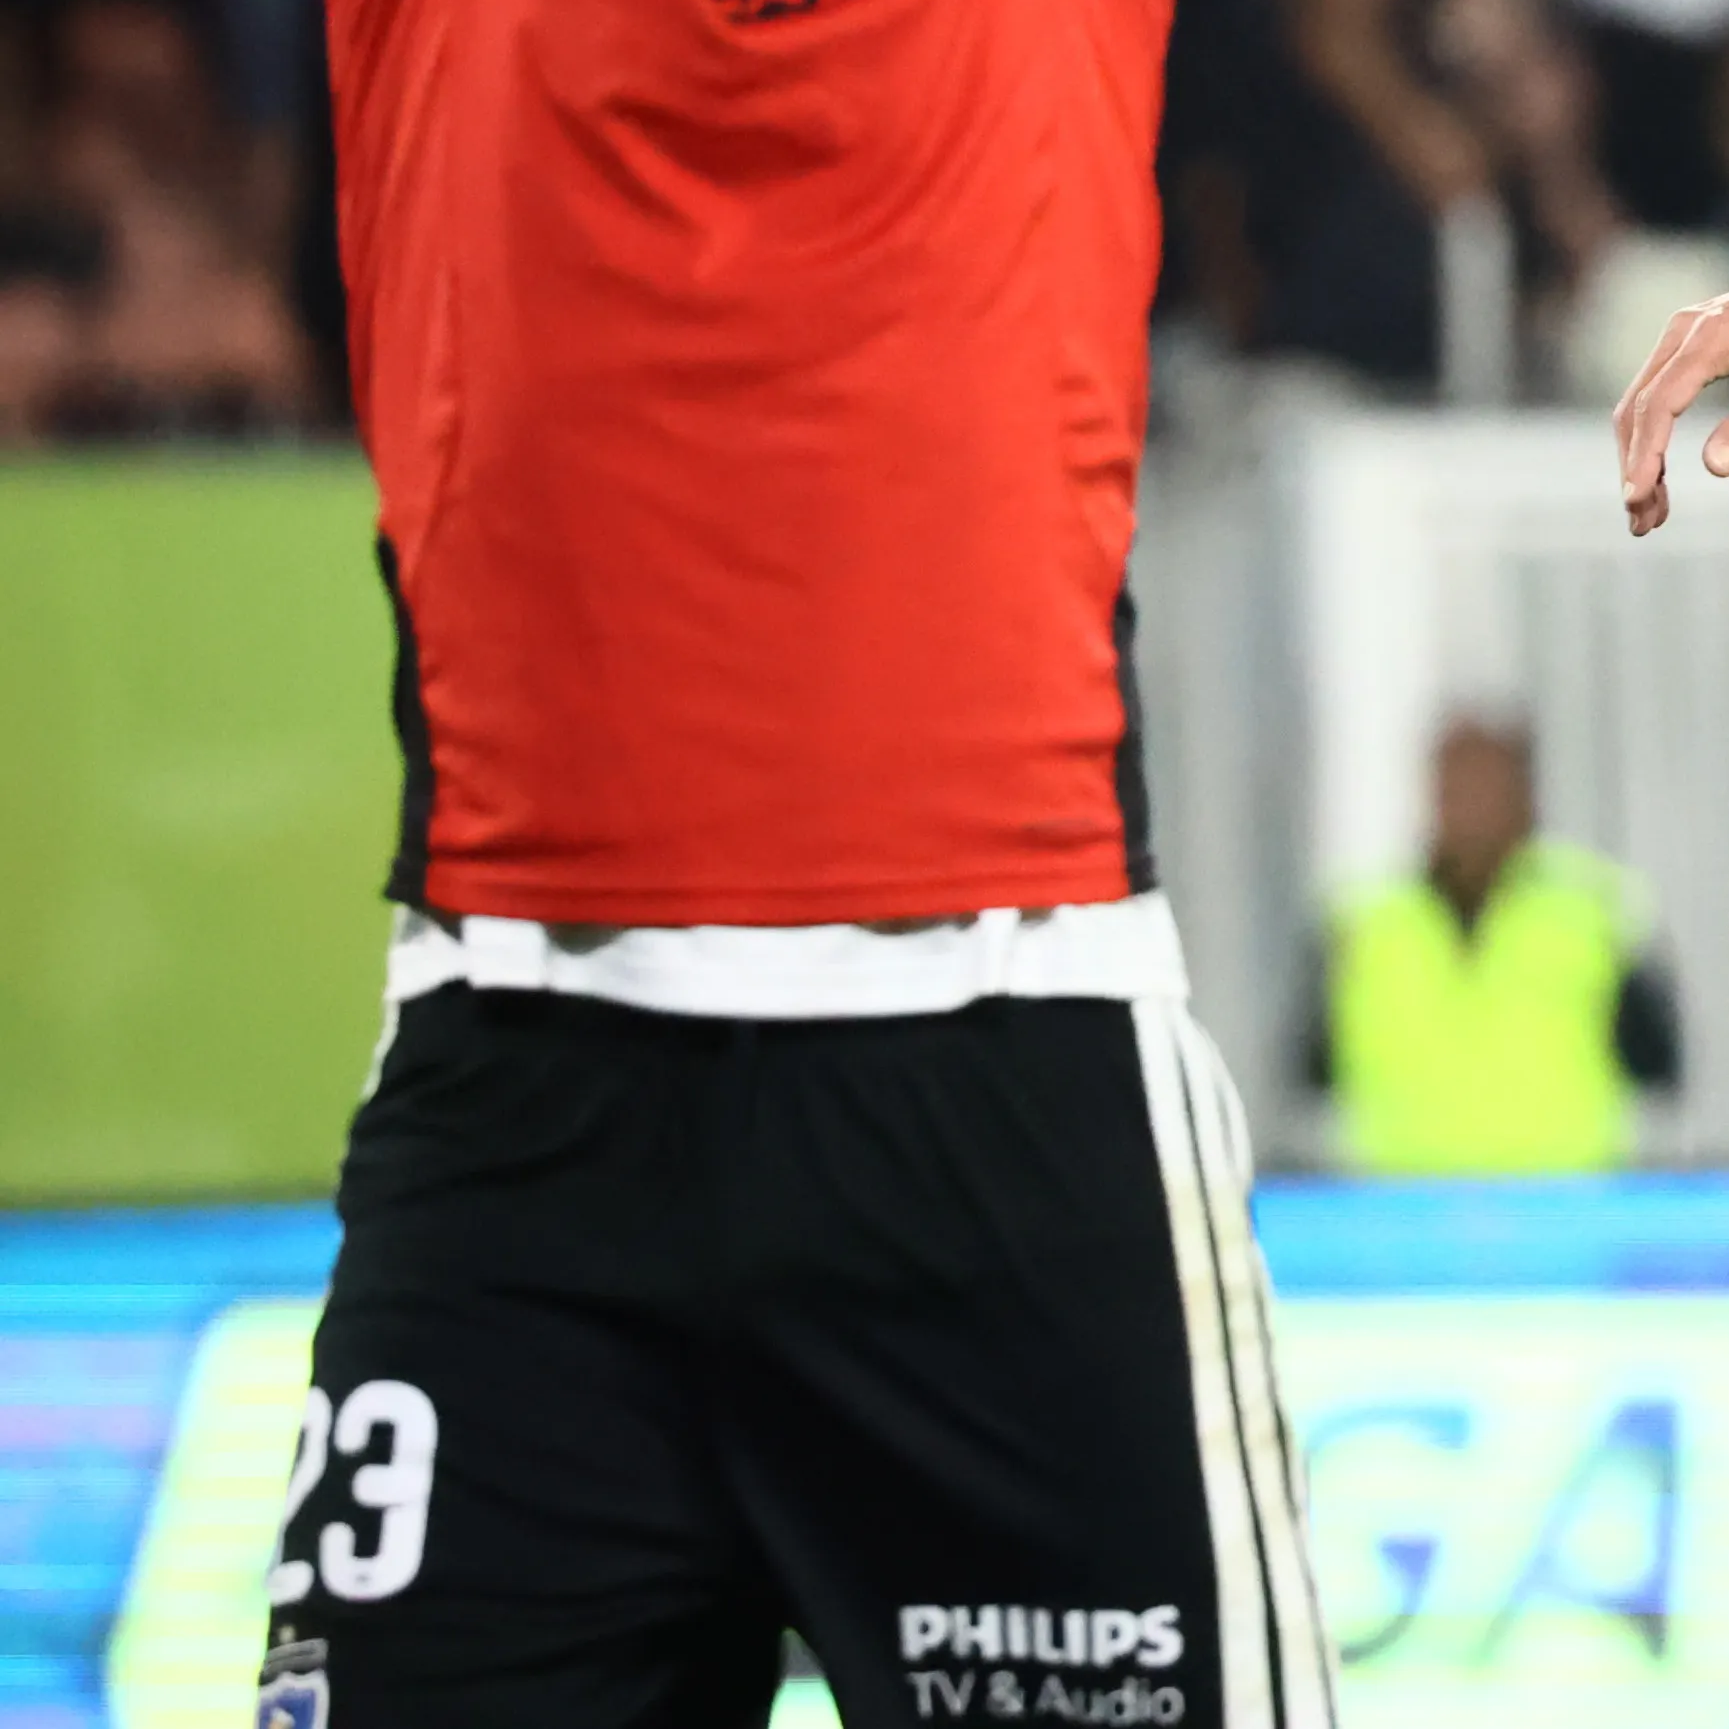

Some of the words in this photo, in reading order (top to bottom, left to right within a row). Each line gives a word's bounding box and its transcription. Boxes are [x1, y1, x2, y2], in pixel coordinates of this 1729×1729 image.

[262, 1378, 439, 1602] 23
[898, 1603, 1186, 1668] PHILIPS
[905, 1669, 977, 1718] TV
[985, 1669, 1024, 1715] &
[1035, 1672, 1186, 1726] Audio
